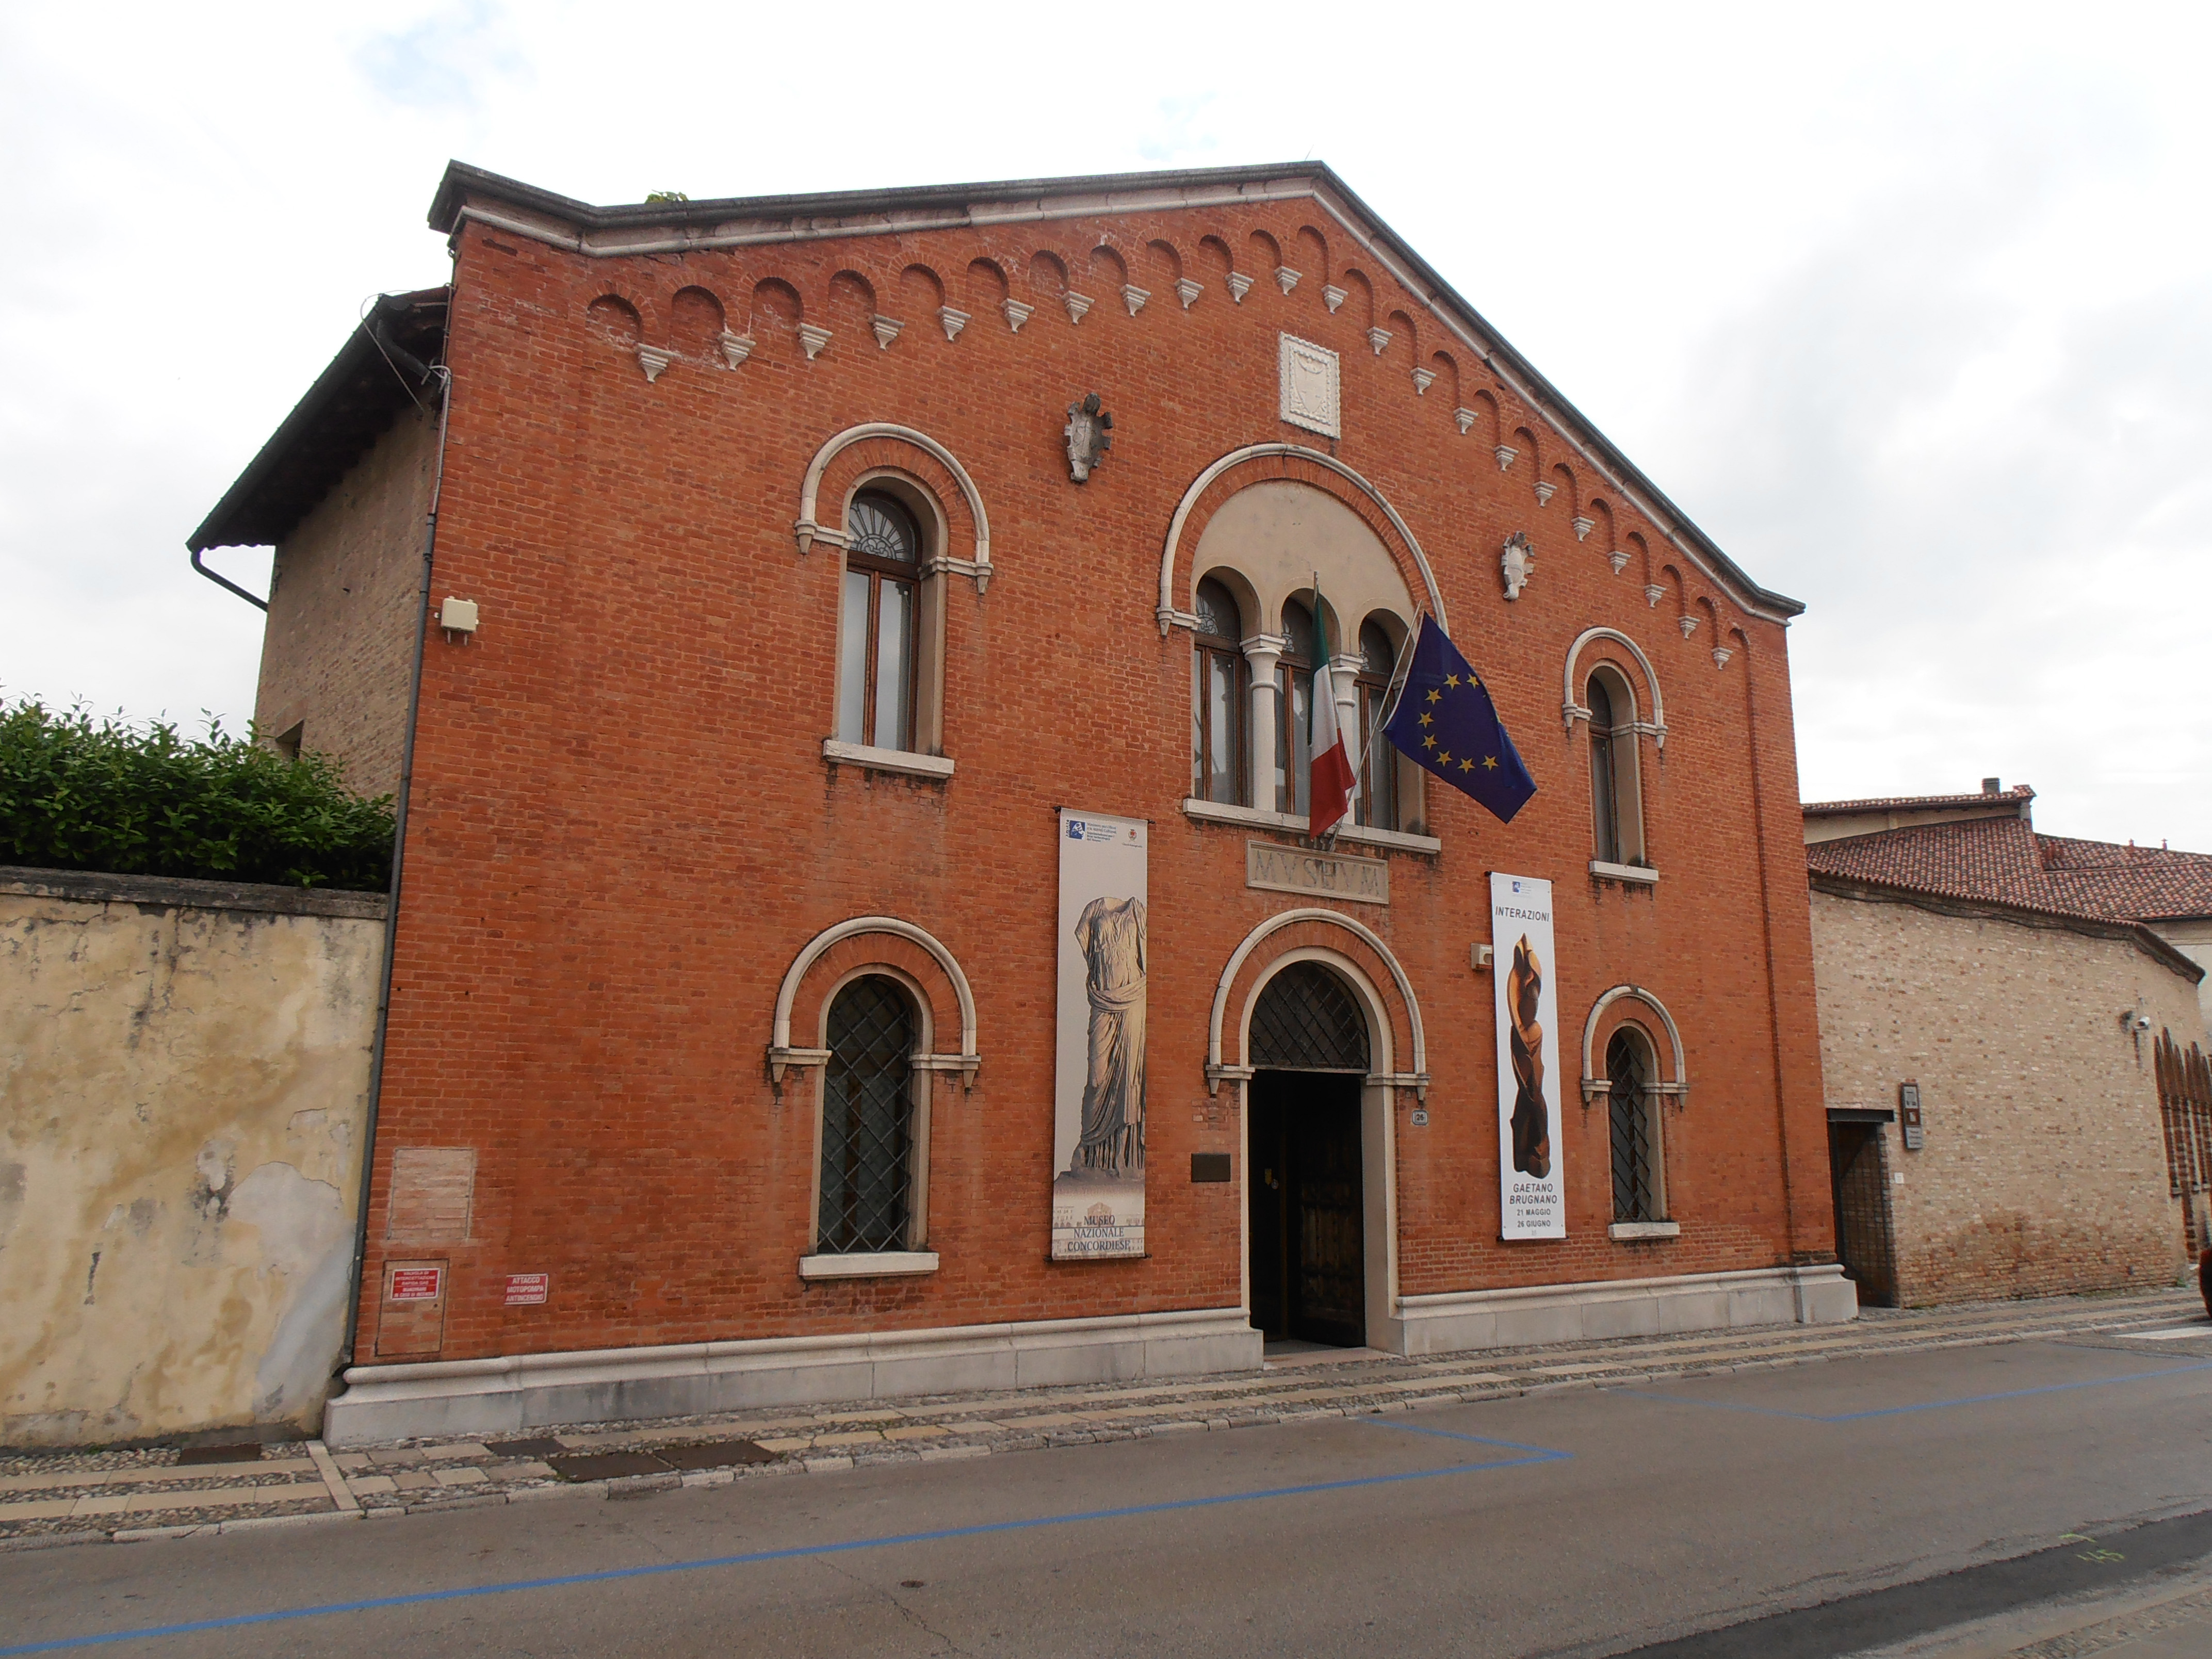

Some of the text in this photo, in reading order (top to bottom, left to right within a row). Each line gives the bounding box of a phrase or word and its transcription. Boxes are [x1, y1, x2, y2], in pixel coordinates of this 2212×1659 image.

[1495, 905, 1550, 922] INTERAZIONI
[1513, 1183, 1553, 1193] GAETANO
[1509, 1195, 1557, 1205] BRUGNANO
[1084, 1215, 1115, 1226] MUSEO
[1074, 1227, 1125, 1239] NAZIONALE
[512, 1276, 540, 1284] ATTACCO
[506, 1285, 544, 1293] MOTOPOMPA
